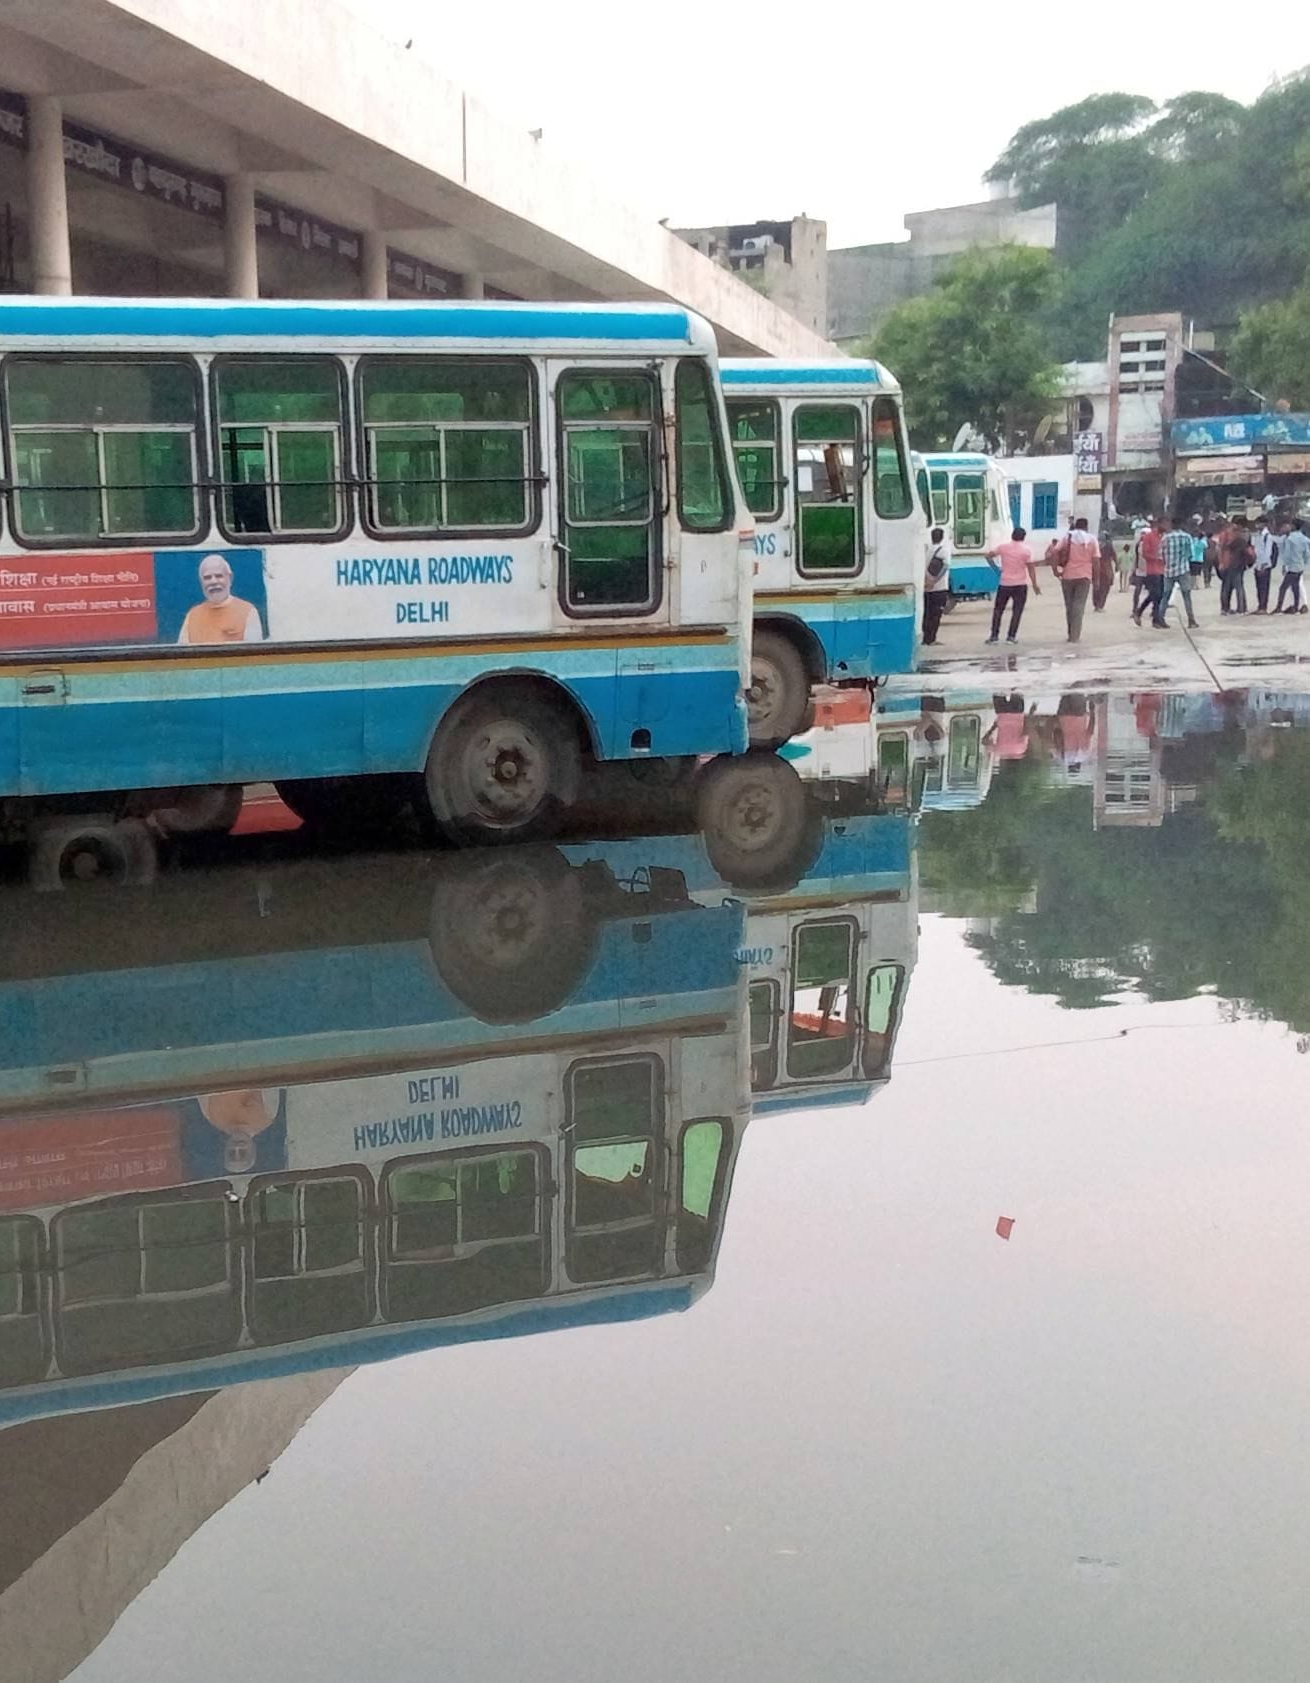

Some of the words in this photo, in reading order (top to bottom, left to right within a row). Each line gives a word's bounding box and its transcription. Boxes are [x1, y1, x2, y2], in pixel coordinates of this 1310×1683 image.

[0, 569, 38, 587] शिक्षा
[336, 557, 422, 586] HARYANA
[428, 555, 514, 585] ROADWAYS
[396, 601, 450, 624] DELHI
